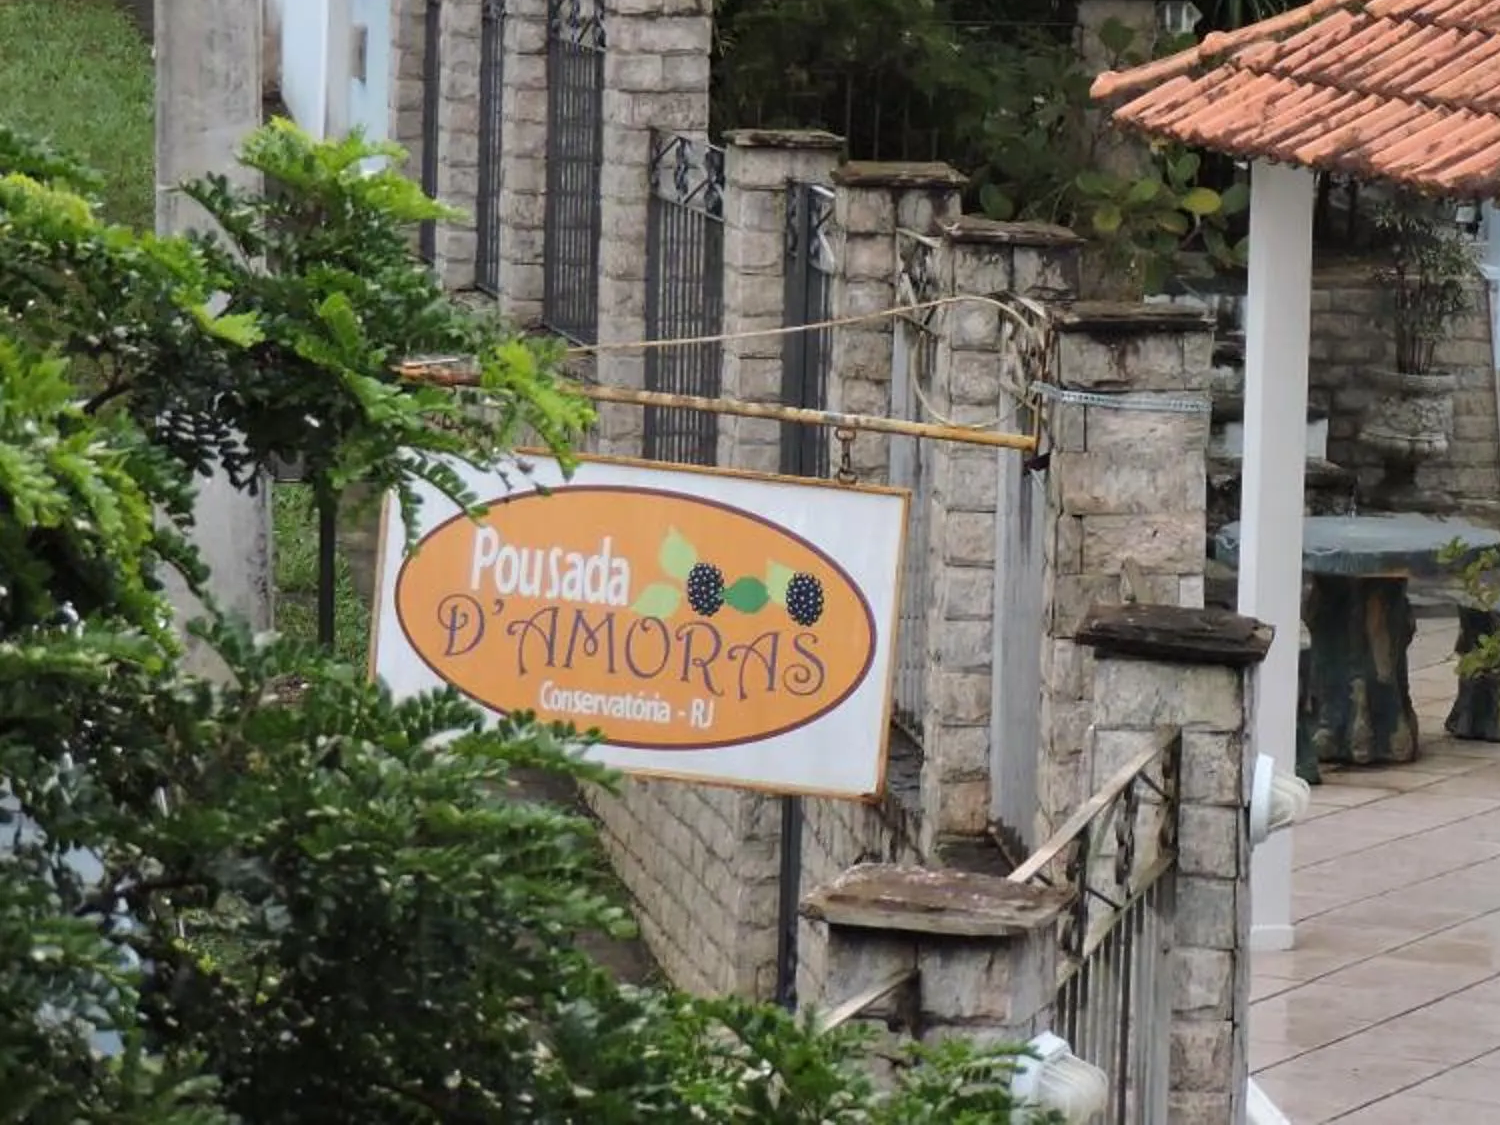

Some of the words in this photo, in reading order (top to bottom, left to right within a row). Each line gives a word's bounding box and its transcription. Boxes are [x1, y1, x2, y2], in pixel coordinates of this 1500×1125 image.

[471, 526, 630, 606] Pousada
[437, 593, 825, 701] D'AMORAS
[539, 681, 671, 723] Conservatória
[690, 699, 713, 729] RJ
